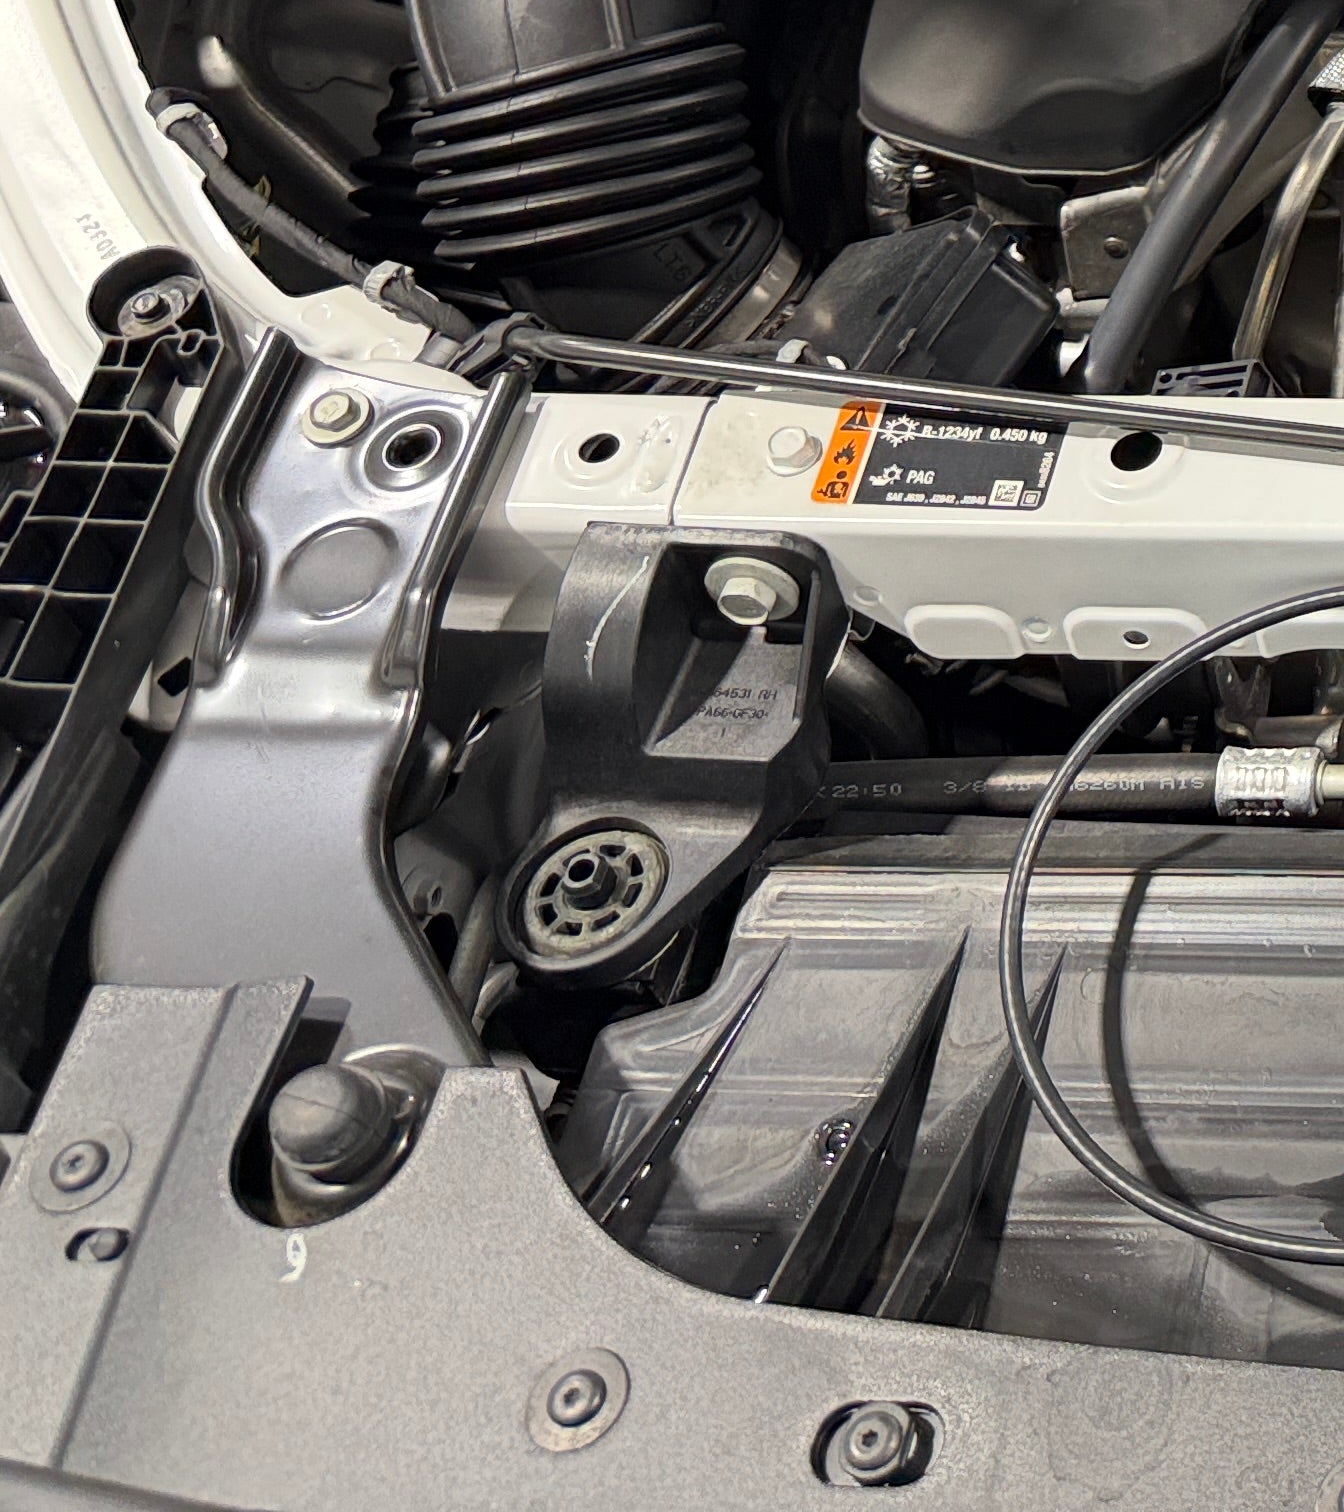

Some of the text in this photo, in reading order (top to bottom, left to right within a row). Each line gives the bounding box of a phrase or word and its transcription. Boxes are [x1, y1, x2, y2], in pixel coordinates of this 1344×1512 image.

[989, 428, 1028, 443] 0.450
[1030, 430, 1048, 445] kg
[905, 470, 936, 486] PAG
